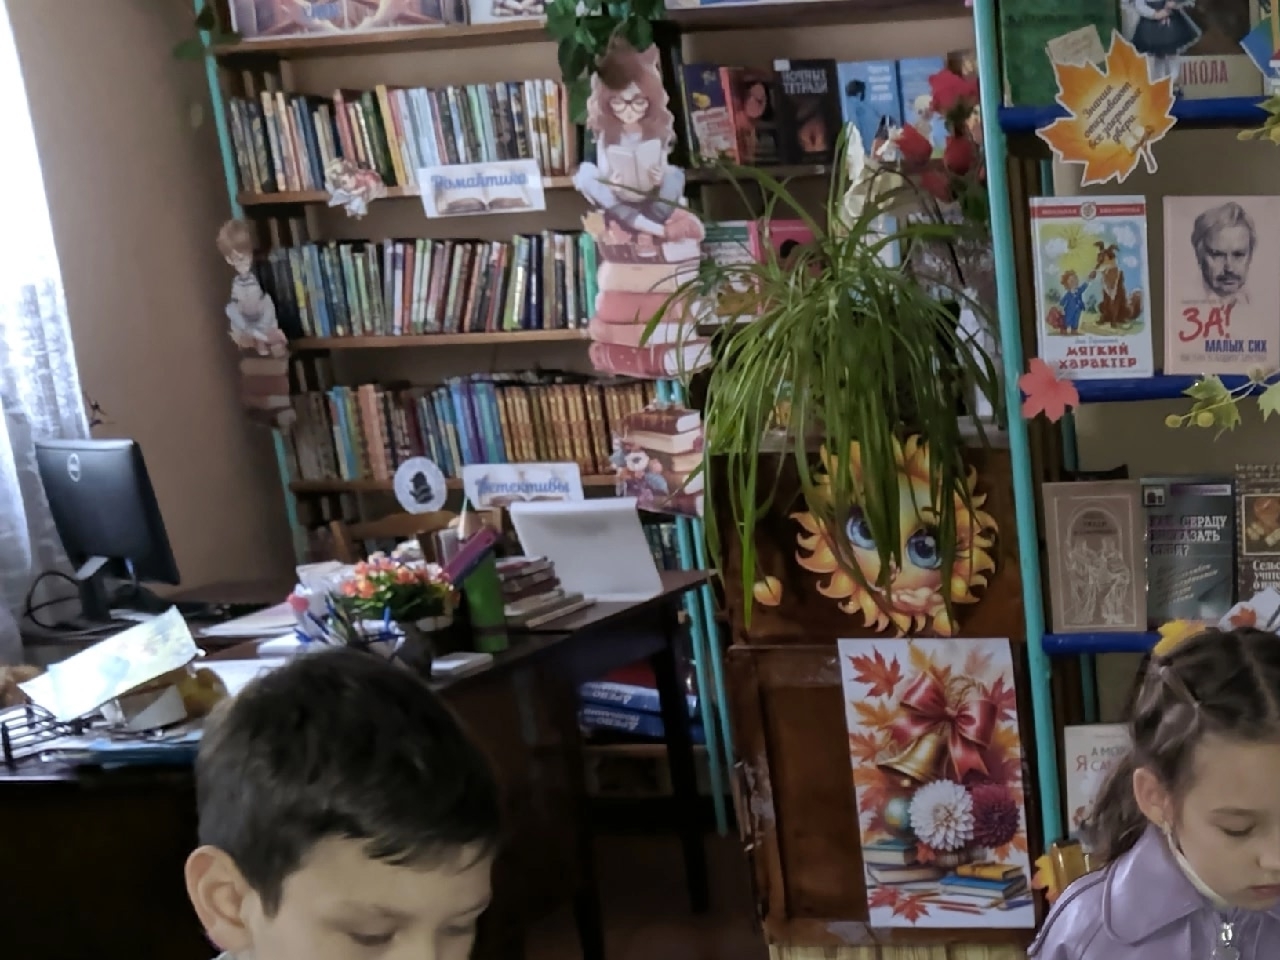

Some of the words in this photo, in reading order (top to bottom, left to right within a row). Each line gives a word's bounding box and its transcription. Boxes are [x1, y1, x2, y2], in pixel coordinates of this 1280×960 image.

[1083, 84, 1113, 118] Знания
[1084, 82, 1132, 138] открывают
[1103, 87, 1142, 138] закрытые
[1205, 340, 1244, 353] МАЛЫХ
[1248, 340, 1267, 353] СИХ
